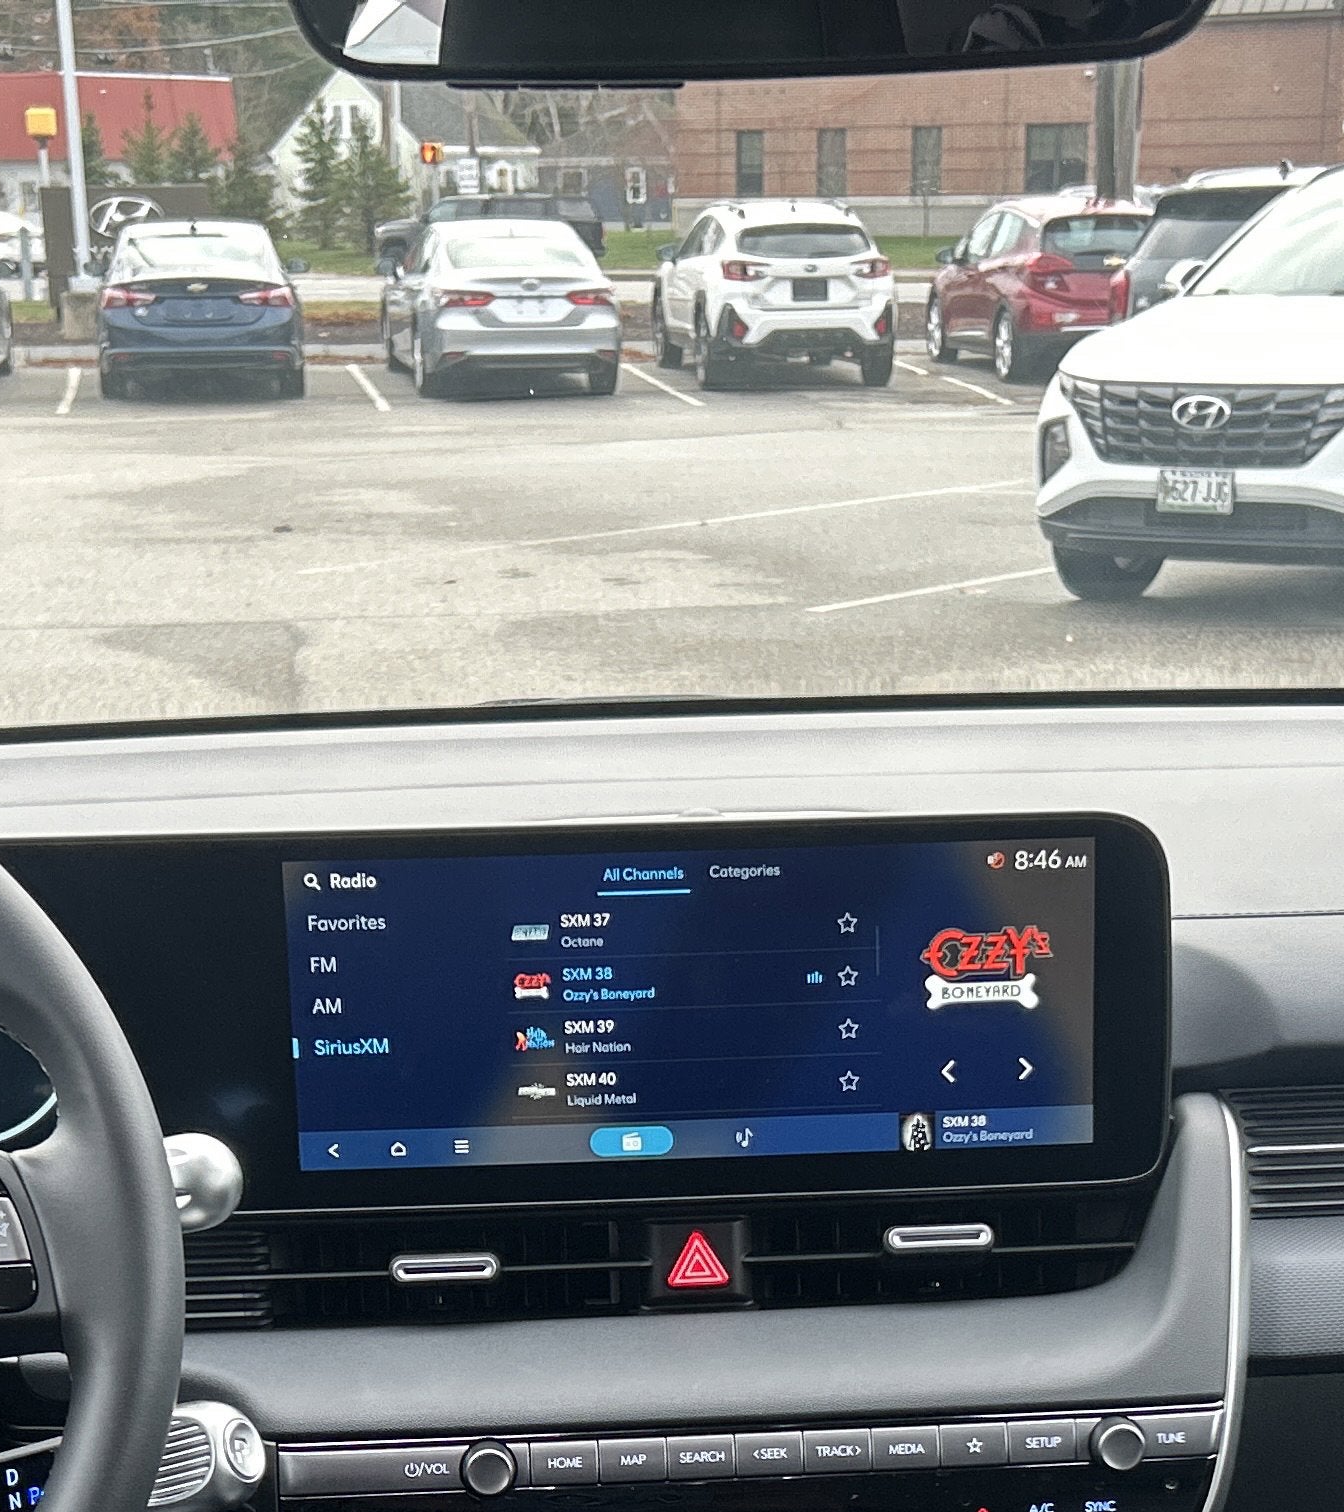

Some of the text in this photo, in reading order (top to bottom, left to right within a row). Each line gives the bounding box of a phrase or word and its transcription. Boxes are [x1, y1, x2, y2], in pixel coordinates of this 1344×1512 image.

[1013, 849, 1088, 871] 8:46 AM
[603, 865, 685, 882] All Channels
[709, 863, 781, 881] Categories
[330, 872, 377, 890] Radio
[307, 914, 387, 933] Favorites
[560, 912, 611, 928] SXM 37
[561, 935, 605, 949] Octane
[309, 955, 338, 974] FM
[562, 966, 614, 982] SXM 38
[562, 986, 656, 1004] Ozzy's Boneyard
[941, 983, 1022, 1000] BONEYARD
[312, 996, 343, 1015] AM
[564, 1019, 616, 1035] SXM 39
[313, 1037, 390, 1057] SiriusXM
[565, 1039, 632, 1055] Hair Nation
[566, 1071, 617, 1087] SXM 40
[566, 1091, 638, 1109] Liquid Metal
[942, 1114, 987, 1129] SXM 38
[942, 1127, 1034, 1144] Ozzy's Boneyard
[1025, 1436, 1063, 1451] SETUP
[1157, 1431, 1187, 1446] TUNE
[678, 1450, 725, 1465] SEARCH
[888, 1442, 926, 1457] MEDIA
[547, 1456, 583, 1470] HOME
[619, 1453, 648, 1467] MAP
[5, 1467, 19, 1487] D
[8, 1491, 22, 1511] N
[27, 1486, 42, 1506] P
[1084, 1500, 1117, 1512] SYNC
